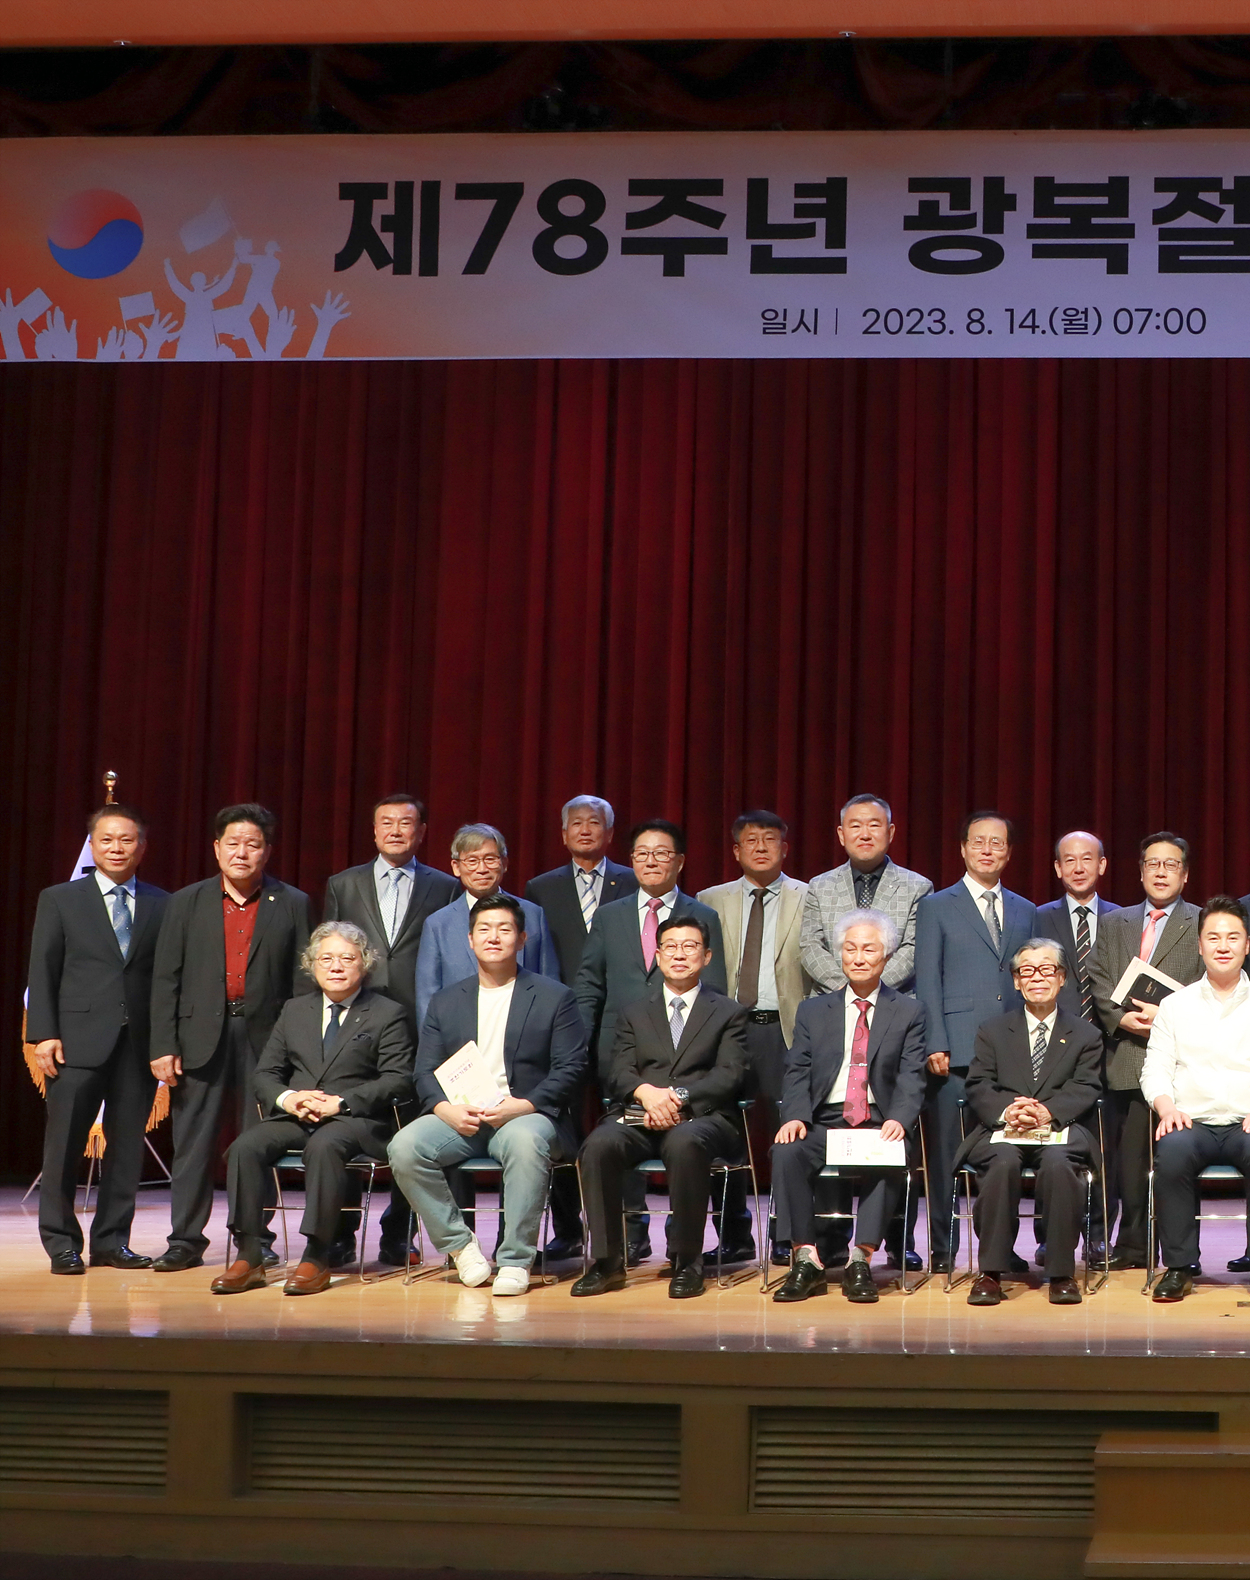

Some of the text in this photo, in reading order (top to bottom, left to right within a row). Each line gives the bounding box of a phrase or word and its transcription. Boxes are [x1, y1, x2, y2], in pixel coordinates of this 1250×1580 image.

[334, 176, 848, 278] 제78주년
[760, 306, 1207, 337] 일시 2023. 8. 14.(월) 07:00
